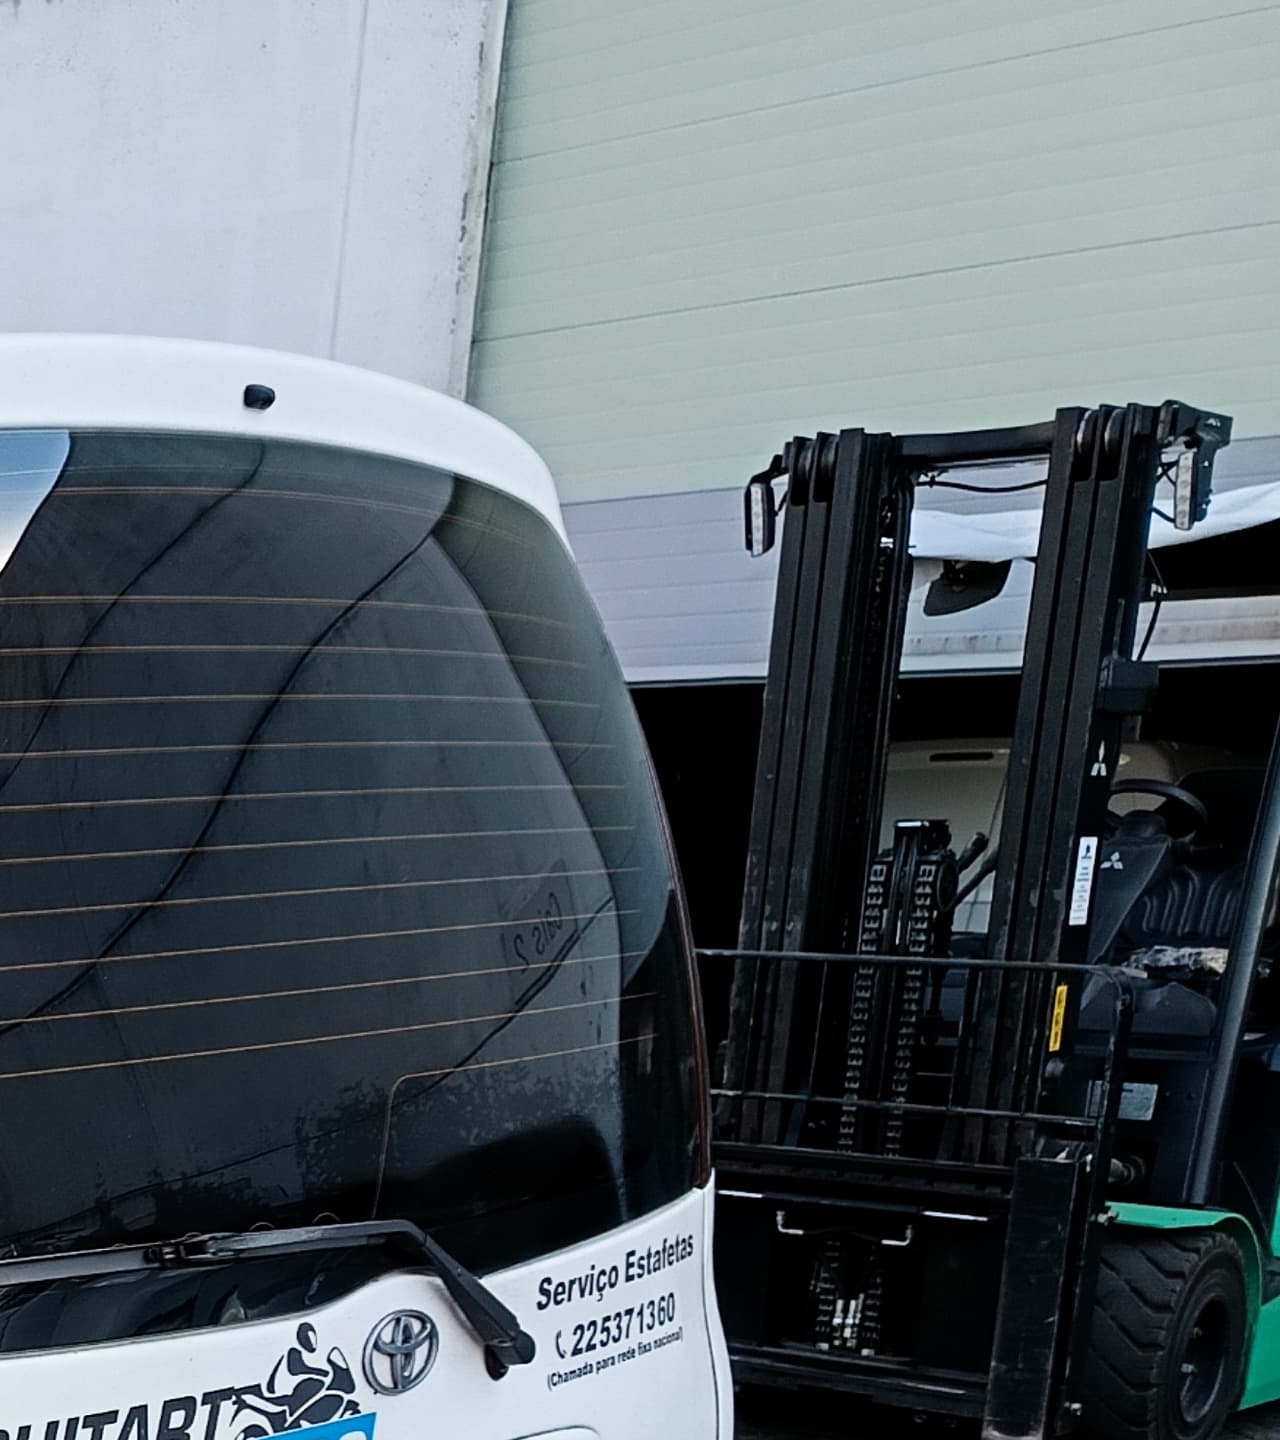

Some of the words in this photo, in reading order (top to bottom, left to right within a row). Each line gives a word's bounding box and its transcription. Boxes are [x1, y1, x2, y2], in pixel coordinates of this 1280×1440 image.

[536, 1264, 619, 1311] Serviço
[624, 1234, 694, 1283] Estafetas
[570, 1292, 676, 1357] 225371360
[547, 1362, 594, 1392] (Chamada
[596, 1354, 616, 1374] para
[617, 1346, 636, 1363] rede
[638, 1340, 652, 1356] fixa
[653, 1326, 684, 1350] nacional)
